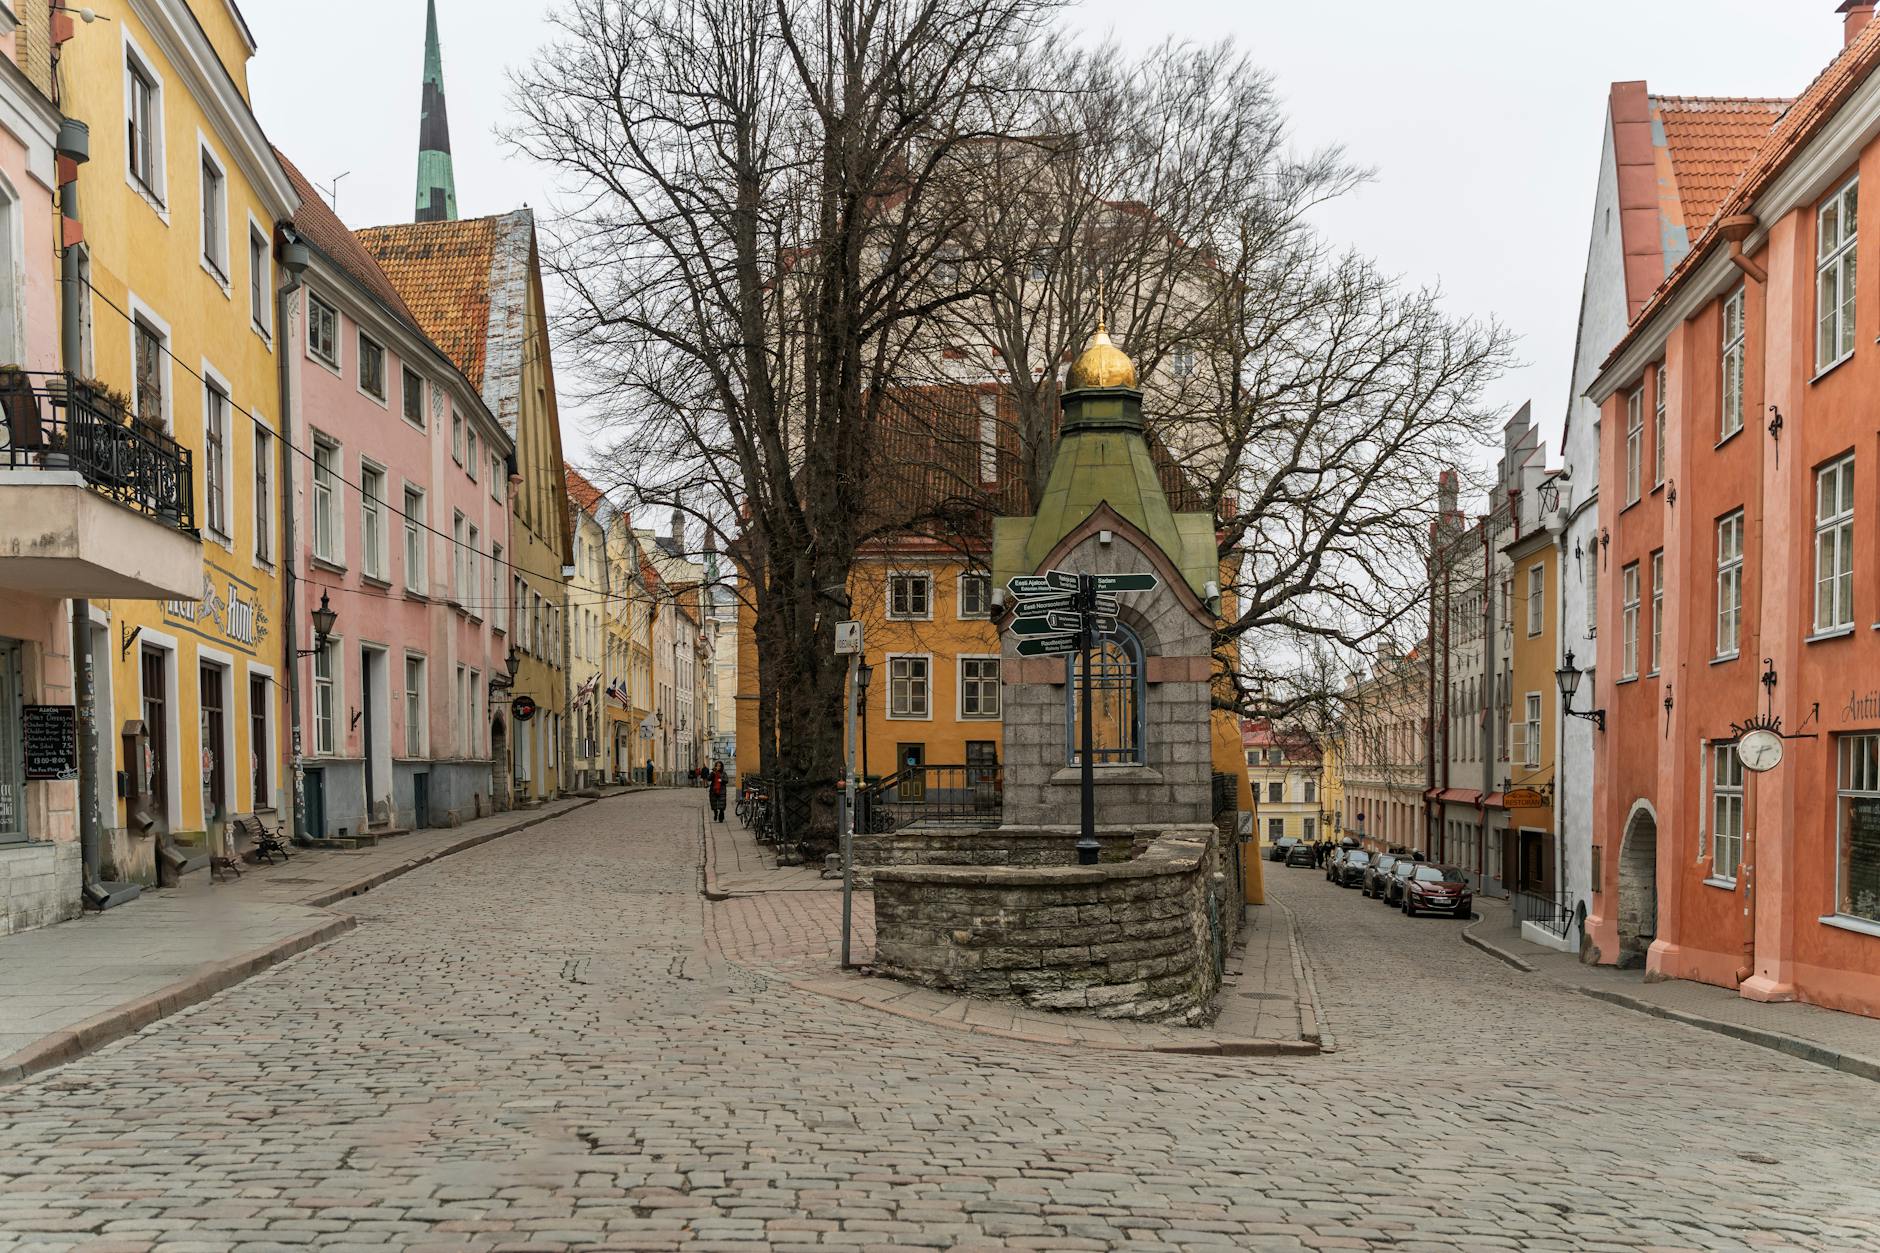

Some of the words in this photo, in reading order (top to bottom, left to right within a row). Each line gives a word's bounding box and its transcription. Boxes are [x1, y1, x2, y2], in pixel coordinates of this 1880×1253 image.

[227, 582, 253, 646] Hunt
[1023, 603, 1036, 611] Eesti
[1842, 689, 1880, 722] Antii
[1505, 799, 1540, 807] RESTORAN
